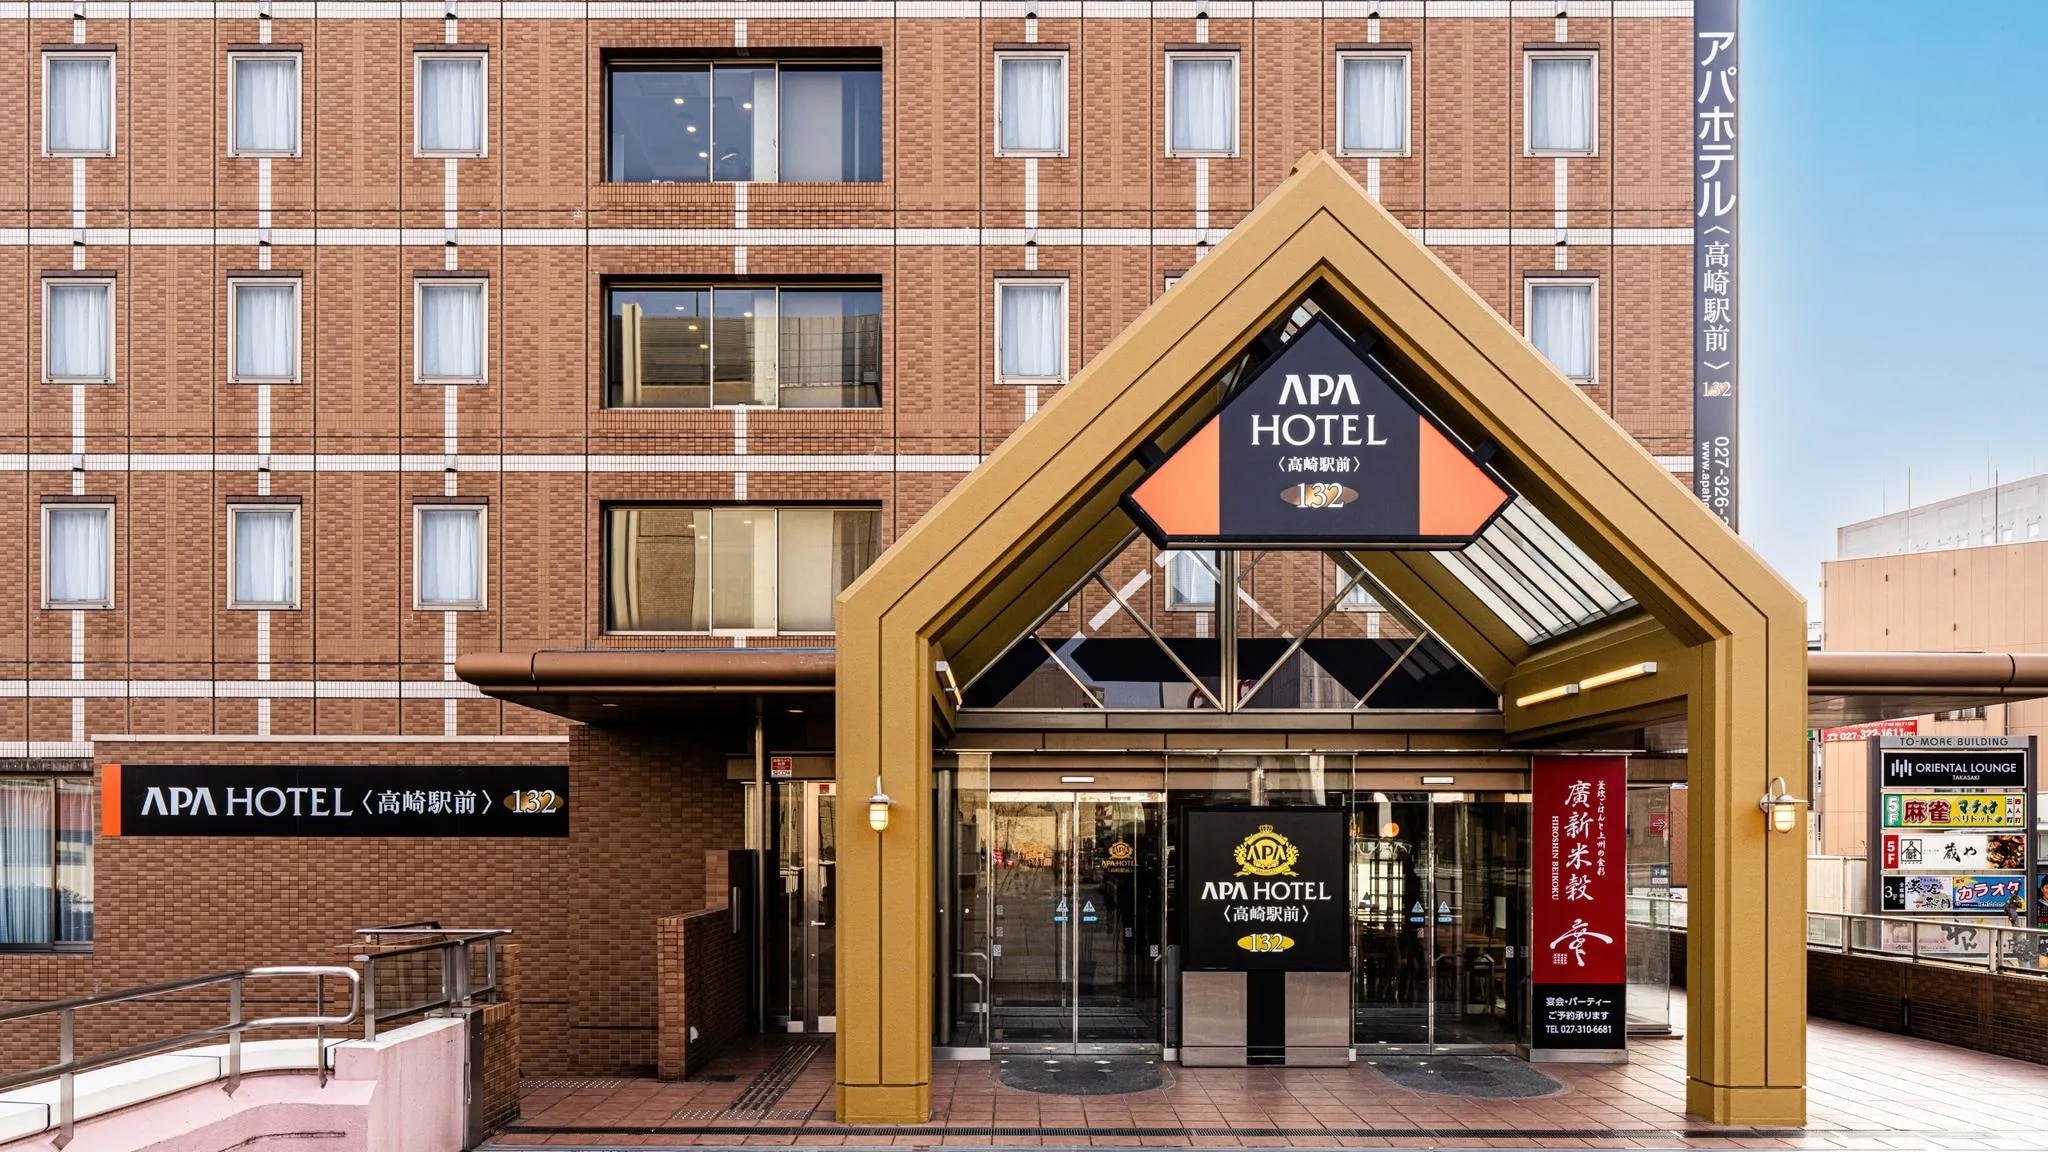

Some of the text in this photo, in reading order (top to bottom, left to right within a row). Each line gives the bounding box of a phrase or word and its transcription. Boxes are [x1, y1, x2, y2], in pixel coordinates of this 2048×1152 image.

[1698, 32, 1737, 217] アパホテル
[1278, 374, 1360, 405] APA
[1702, 381, 1732, 397] 132
[1251, 414, 1388, 446] HOTEL
[1296, 482, 1344, 509] 132
[1900, 738, 2009, 746] TO-MORE BUILDING
[1915, 763, 2017, 773] ORIENTAL LOUNGE
[141, 787, 217, 816] APA
[226, 787, 354, 816] HOTEL
[511, 789, 557, 815] 132
[1904, 799, 1951, 823] 麻雀
[1247, 845, 1287, 861] APA
[1551, 816, 1559, 900] HIROSHIN BEIKOKU
[1887, 841, 1895, 864] 5F
[1201, 881, 1332, 901] APA HOTEL
[1958, 881, 2020, 900] カラオケ
[1250, 932, 1284, 953] 132
[1546, 996, 1612, 1007] 宴会・パーティー
[1548, 1010, 1610, 1020] ご予約承ります
[1545, 1024, 1612, 1034] TEL 027-310-6681
